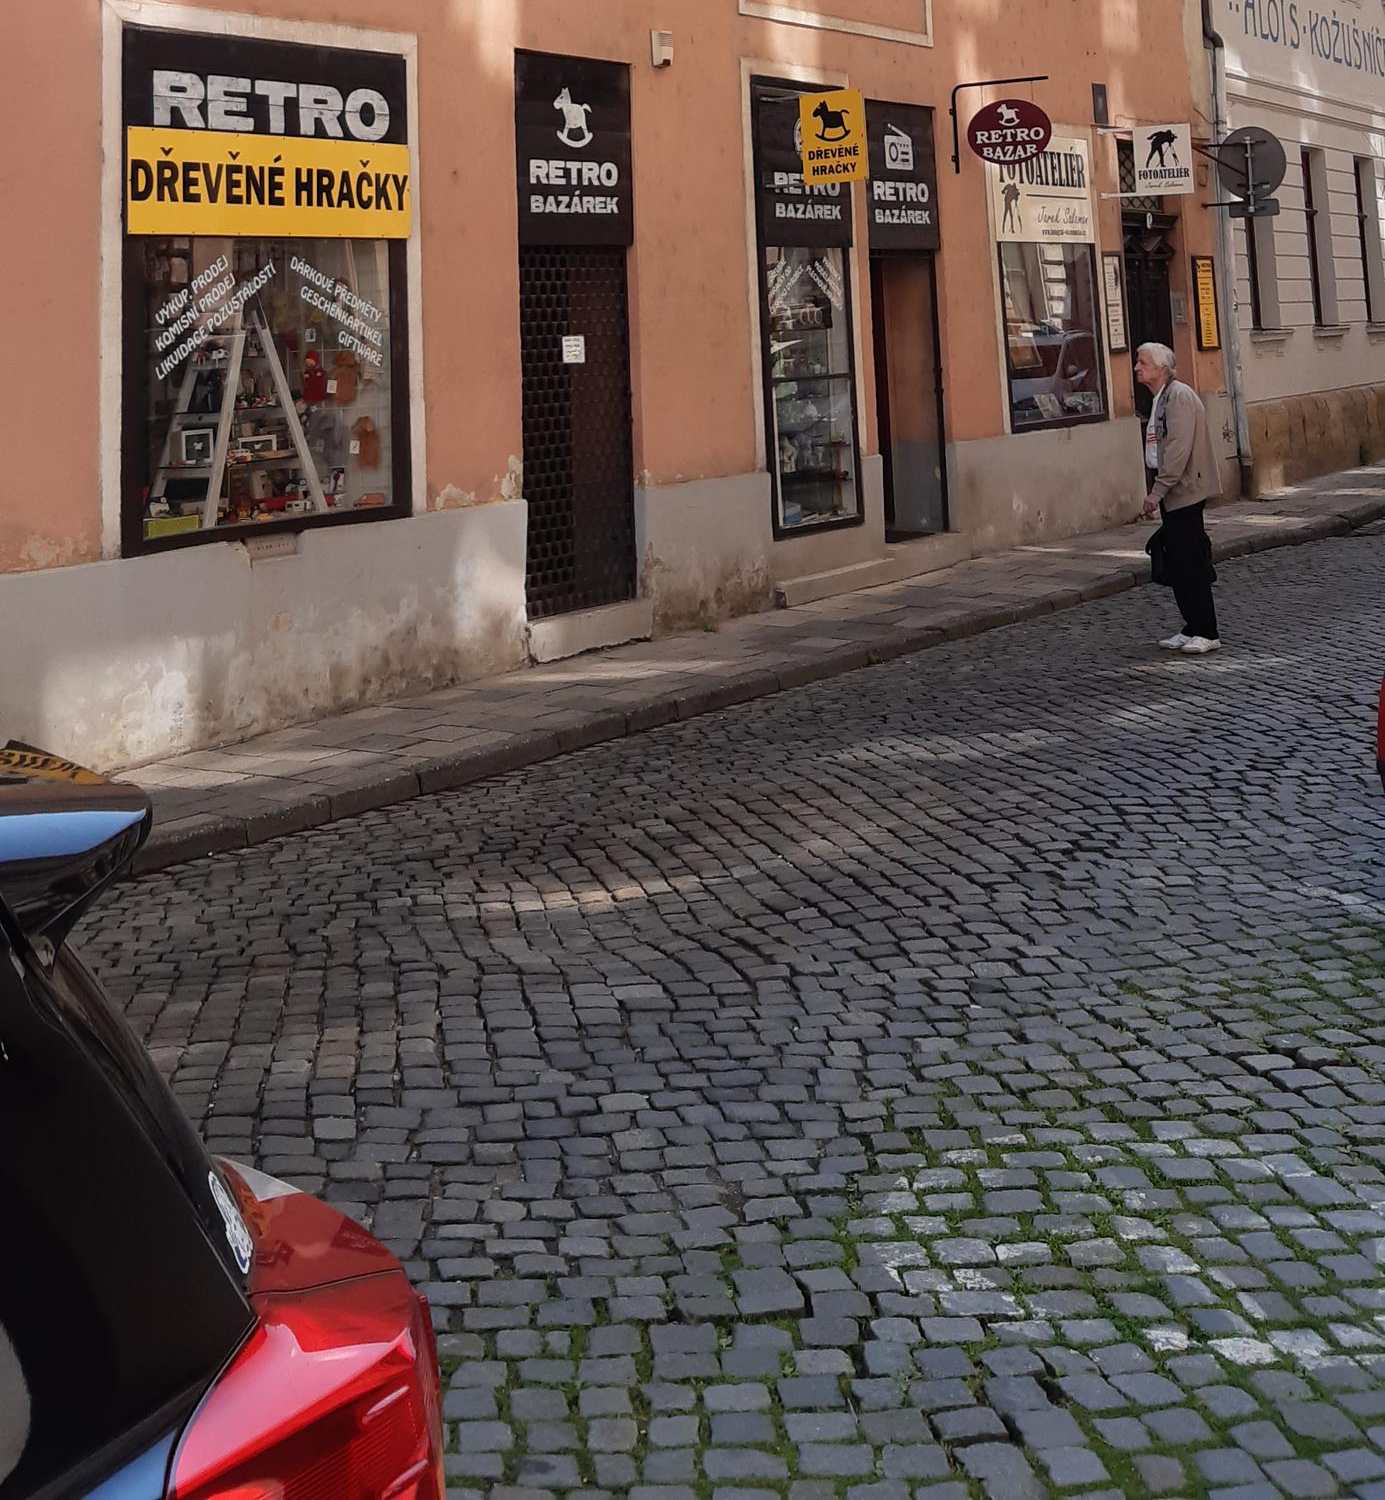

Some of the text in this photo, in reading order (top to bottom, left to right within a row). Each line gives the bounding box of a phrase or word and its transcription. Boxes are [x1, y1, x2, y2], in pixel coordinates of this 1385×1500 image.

[152, 69, 391, 141] RETRO
[976, 127, 1044, 144] RETRO
[808, 143, 859, 161] DŘEVĚNÉ
[982, 144, 1038, 160] BAZAR
[130, 147, 409, 211] DŘEVĚNÉ HRAČKY
[529, 158, 618, 187] RETRO
[812, 161, 857, 176] HRAČKY
[530, 189, 619, 213] BAZÁREK
[873, 180, 930, 203] RETRO
[775, 199, 841, 220] BAZÁREK
[875, 205, 931, 224] BAZÁREK
[191, 254, 229, 294] PRODEJ
[199, 272, 236, 312] PRODEJ
[290, 256, 382, 322] DÁRKOVÉ PŘEDMĚTY
[300, 286, 382, 347] GESCHENKARTIKEL
[155, 325, 208, 380] LIKVIDACE
[338, 331, 383, 367] GIFTWARE
